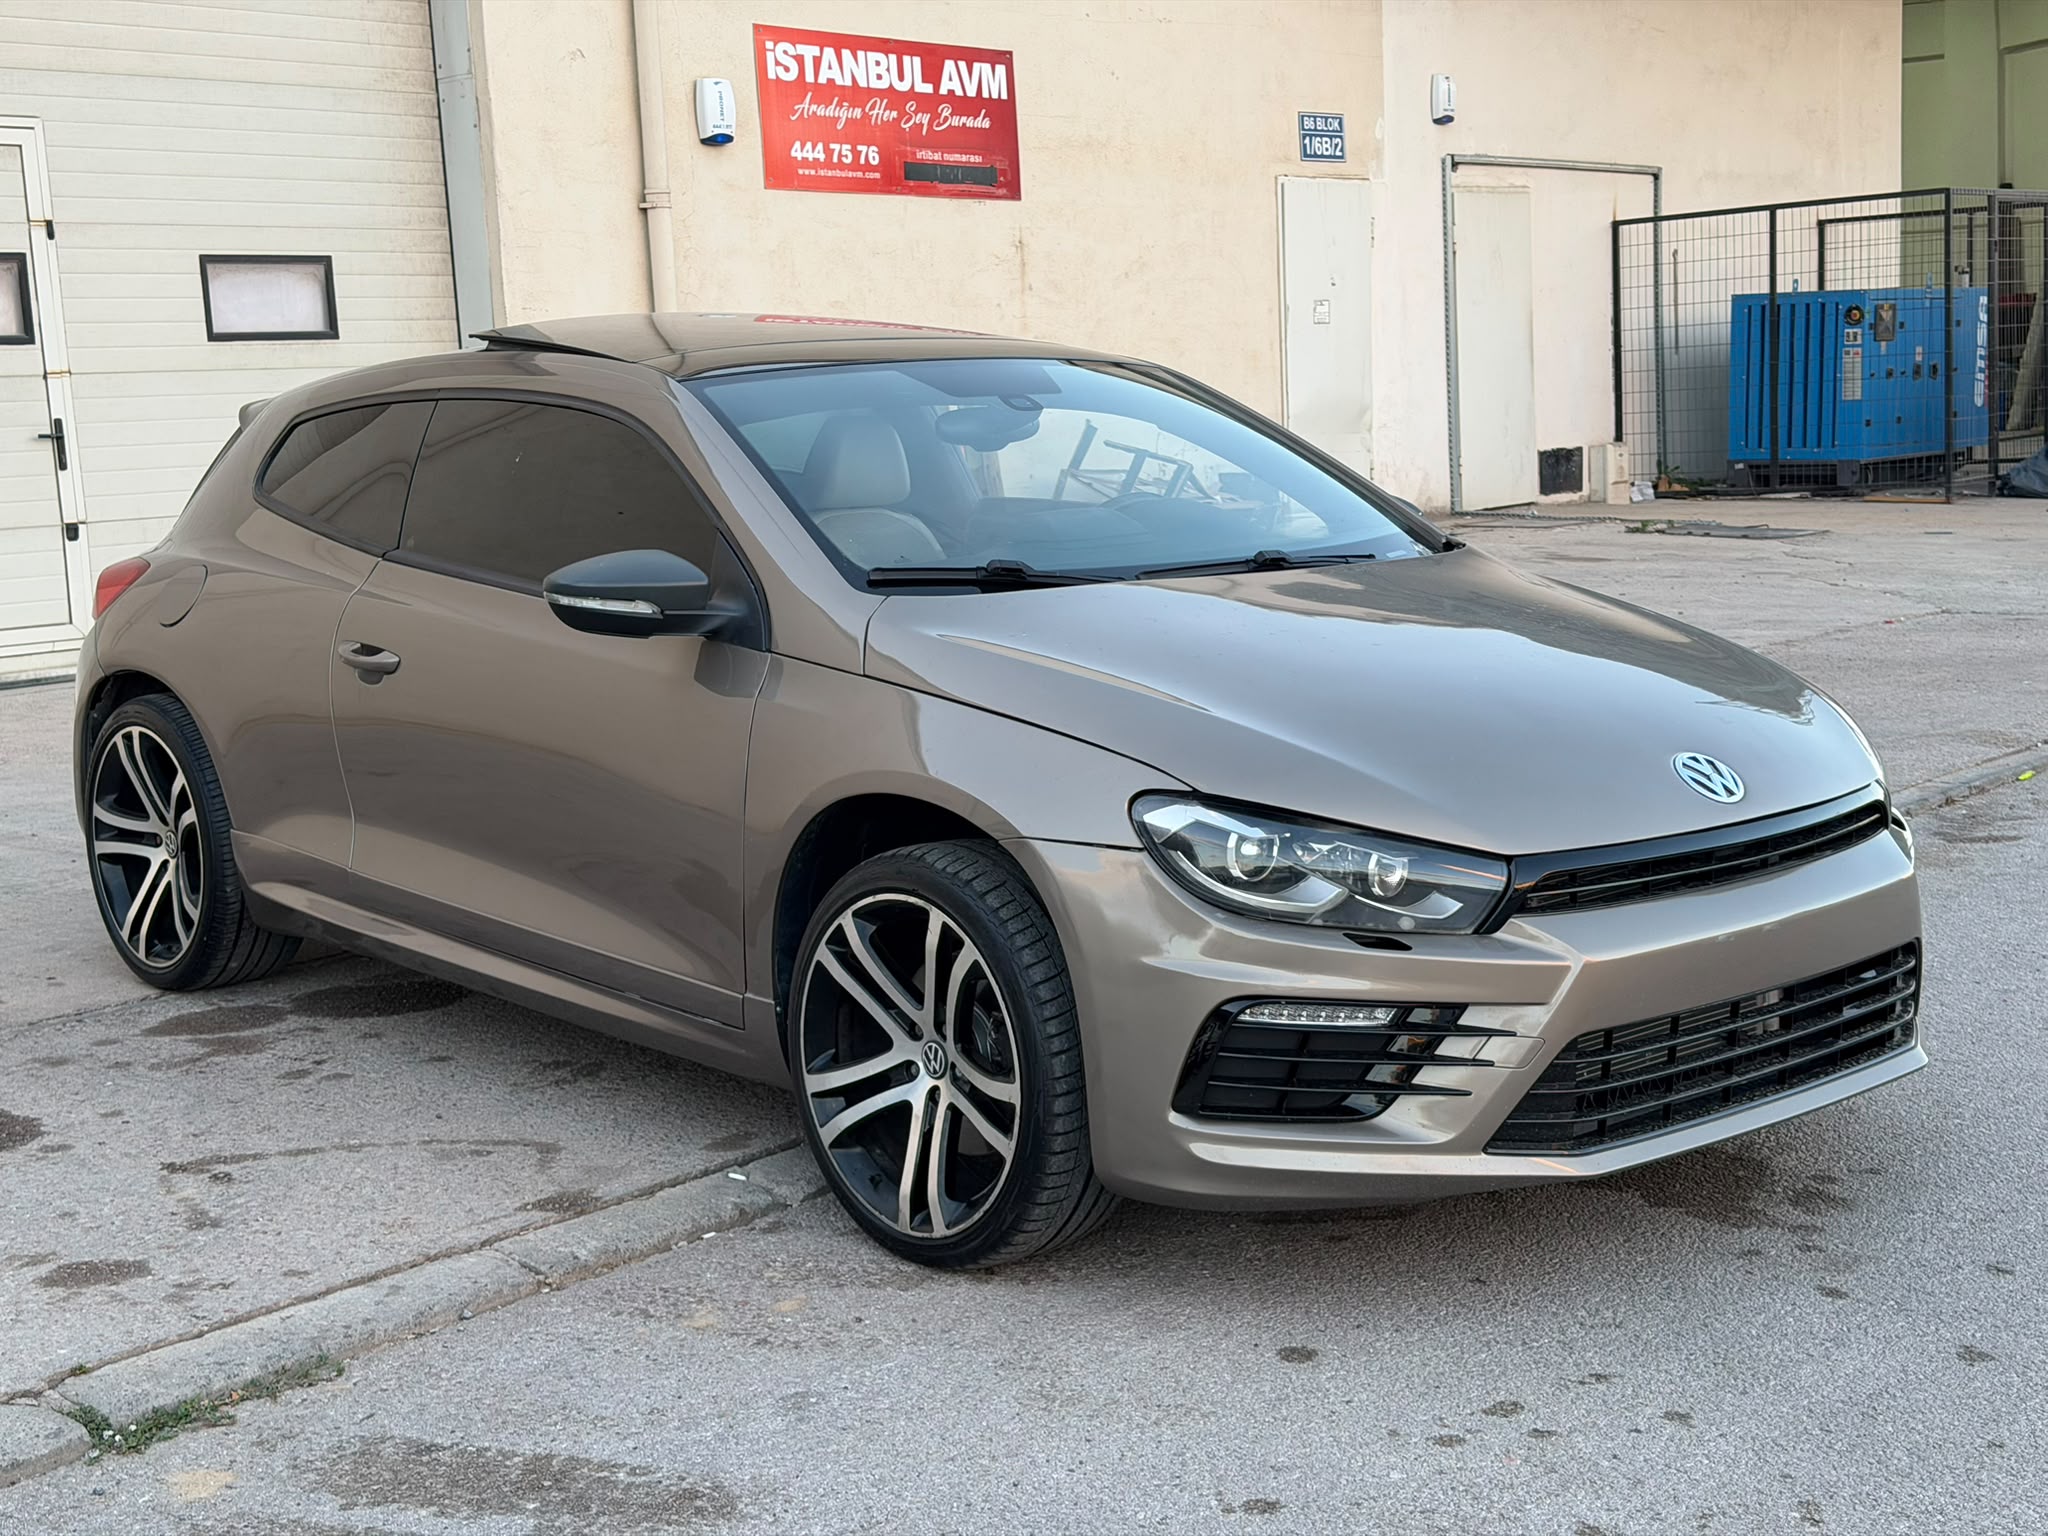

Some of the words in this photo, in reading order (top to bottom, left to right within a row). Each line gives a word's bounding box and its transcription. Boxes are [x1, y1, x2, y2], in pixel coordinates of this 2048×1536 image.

[939, 58, 1008, 100] AVM
[865, 97, 898, 126] Her
[932, 103, 992, 131] Burada
[1303, 116, 1315, 130] B6
[1316, 117, 1341, 132] BLOK
[790, 140, 826, 163] 444
[829, 143, 853, 164] 75
[856, 145, 880, 166] 76
[1303, 136, 1343, 156] 1/6B/2
[797, 167, 881, 179] www.istanbulavm.com
